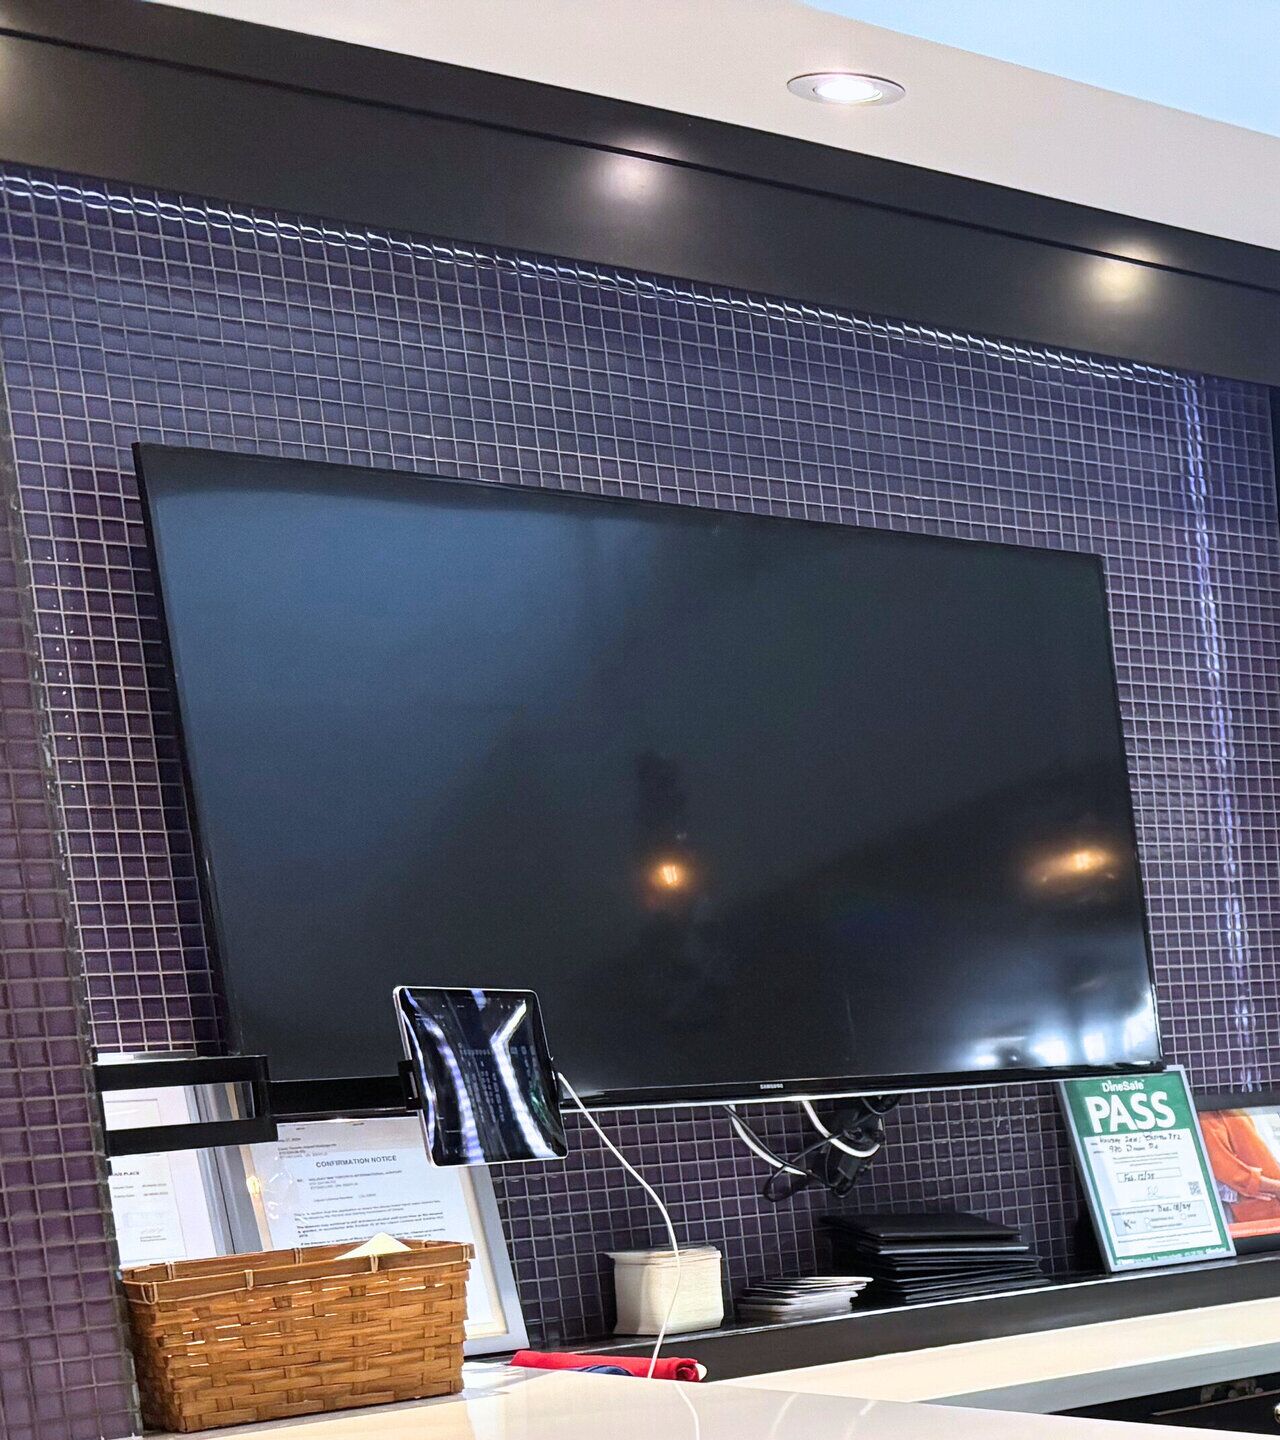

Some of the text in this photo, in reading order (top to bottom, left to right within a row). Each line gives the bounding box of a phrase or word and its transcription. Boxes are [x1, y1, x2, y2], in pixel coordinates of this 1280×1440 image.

[1101, 1080, 1145, 1092] DineSafe
[1084, 1091, 1176, 1134] PASS
[316, 1155, 397, 1168] CONFIRMATION NOTICE
